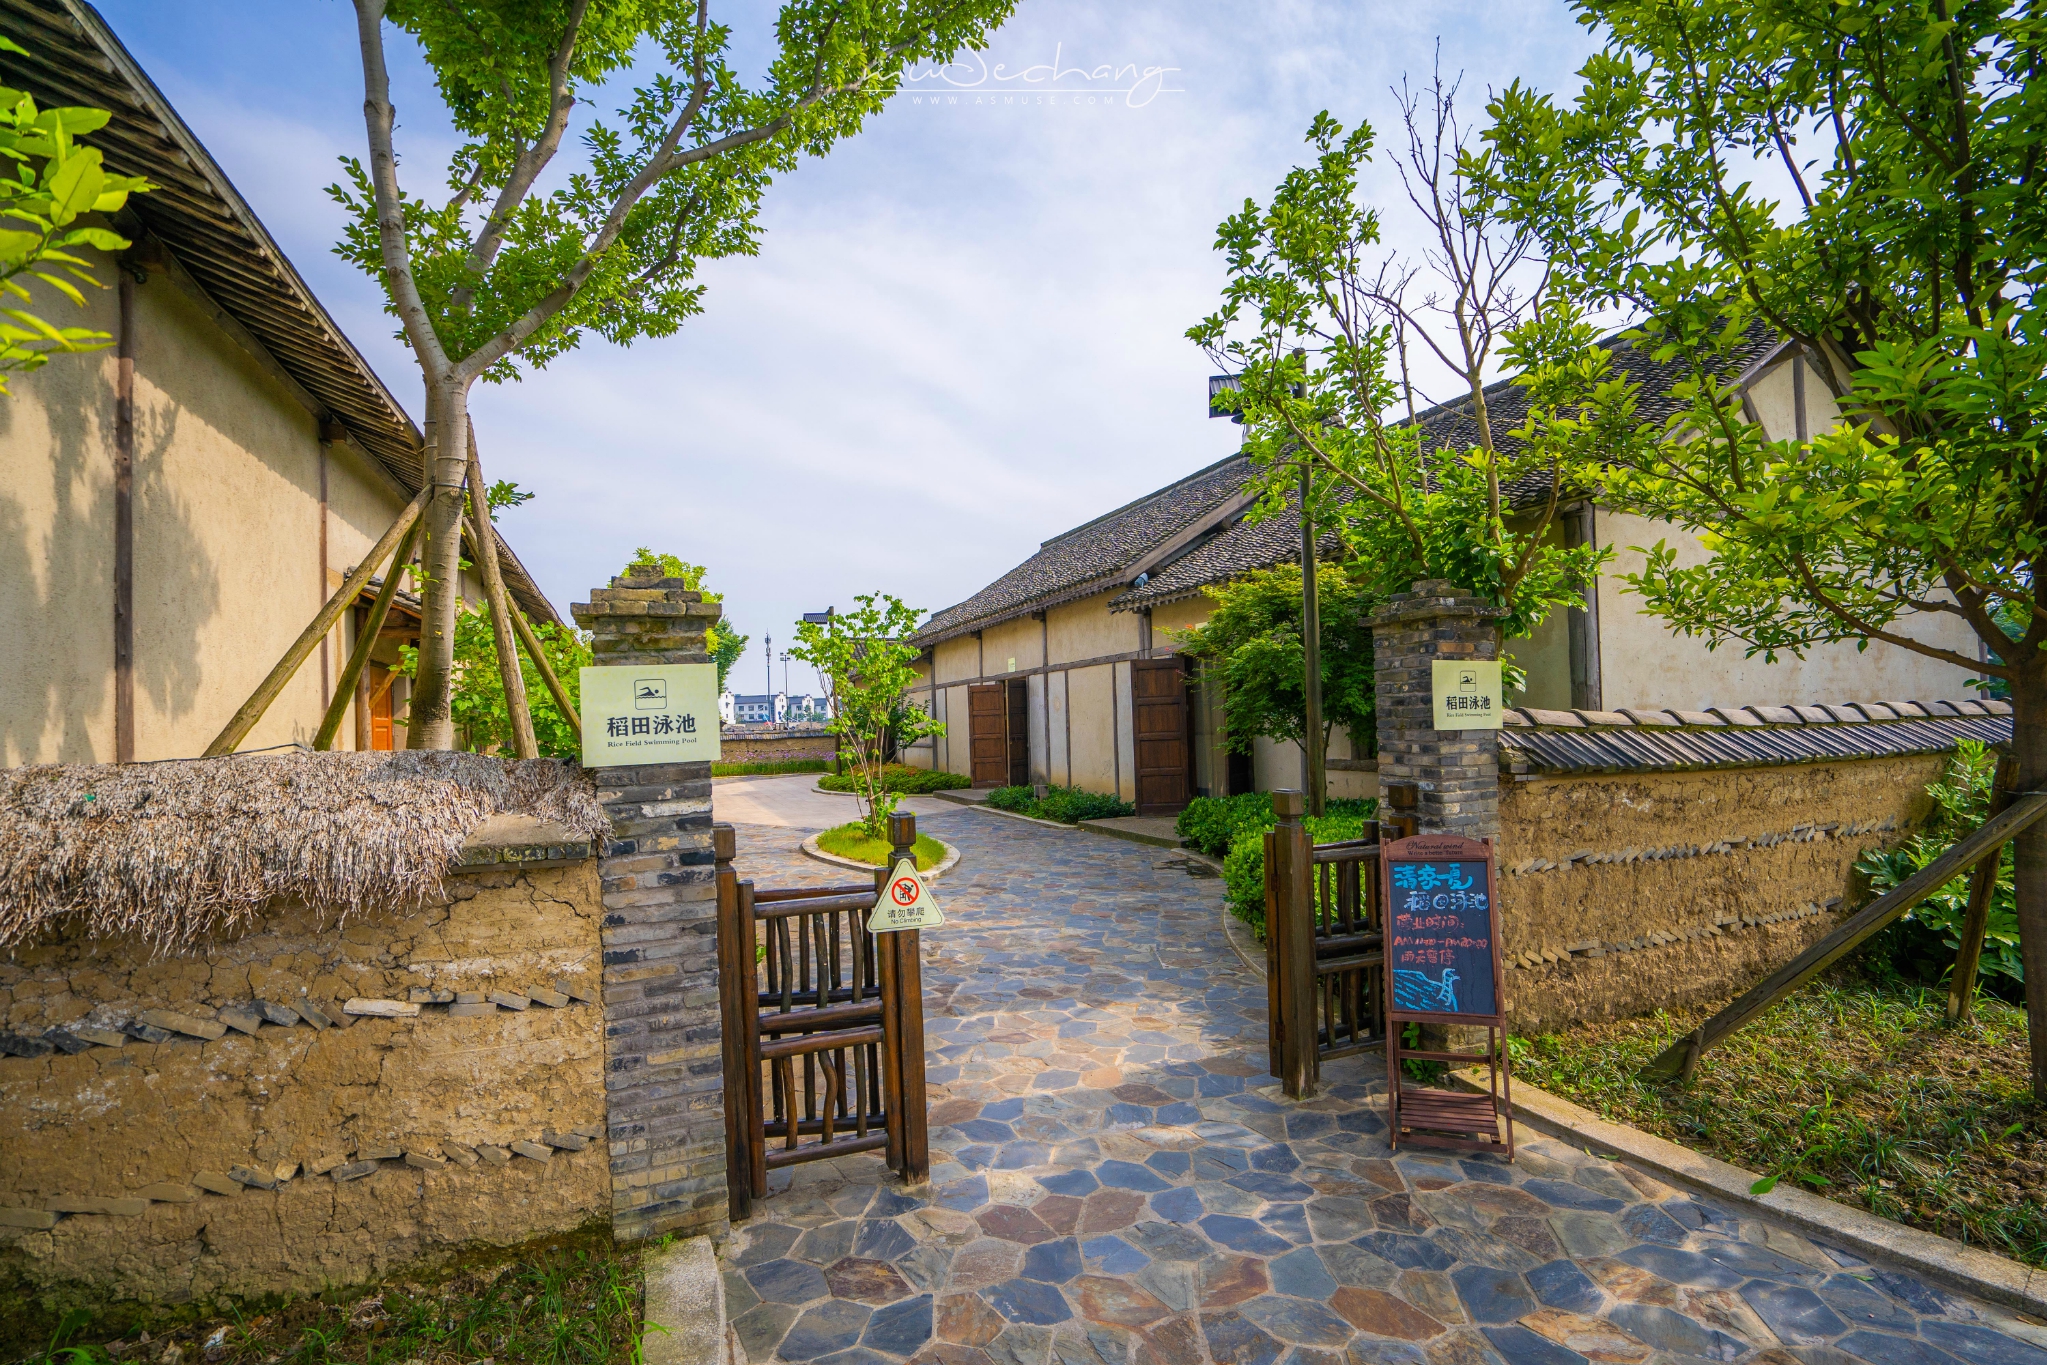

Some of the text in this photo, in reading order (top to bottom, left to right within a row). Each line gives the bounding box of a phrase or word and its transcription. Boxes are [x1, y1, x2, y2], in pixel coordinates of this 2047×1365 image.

[1446, 695, 1491, 710] 稻田泳池
[606, 713, 697, 738] 稻田泳池
[1406, 841, 1443, 850] Natural
[1393, 863, 1474, 890] 清凉一夏
[1403, 890, 1489, 912] 稻田泳池
[887, 907, 925, 918] 请勿攀爬
[1401, 948, 1456, 966] 雨天暂停
